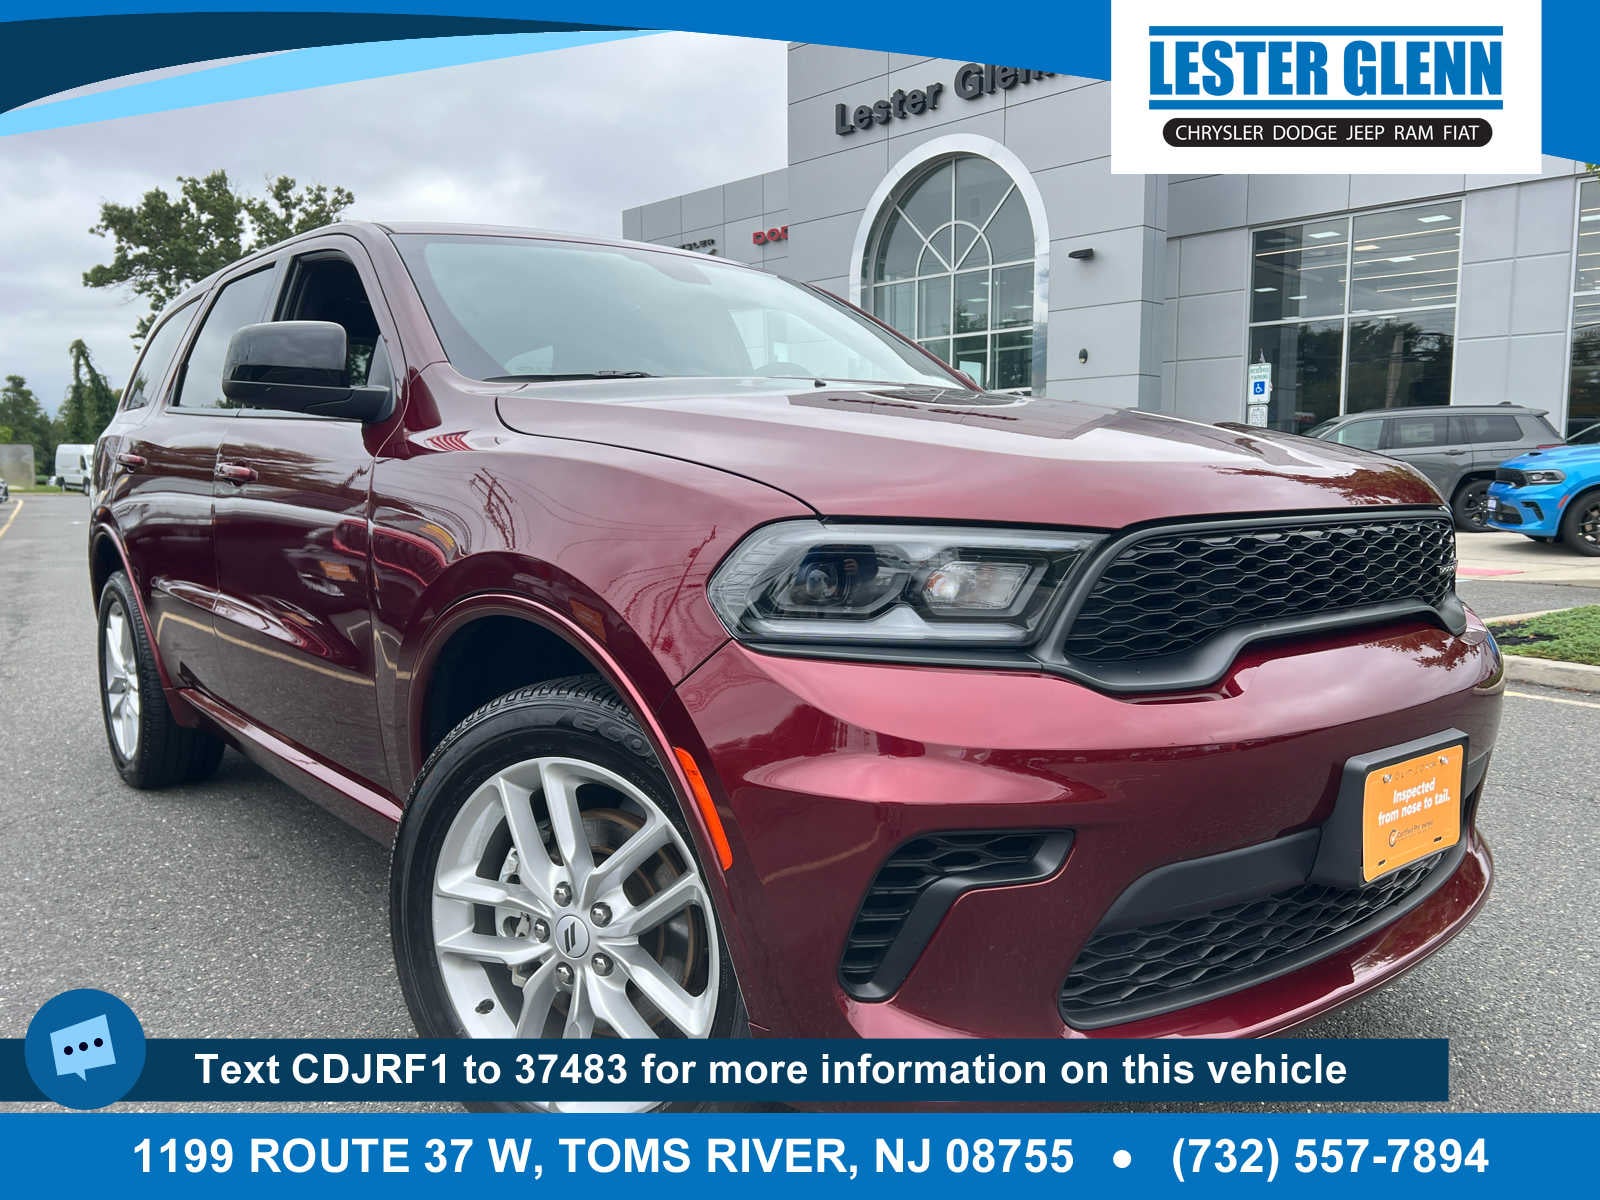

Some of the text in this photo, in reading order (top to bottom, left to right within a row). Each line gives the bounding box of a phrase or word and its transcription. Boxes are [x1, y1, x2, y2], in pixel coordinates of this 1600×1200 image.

[835, 62, 1056, 136] Lester Gle
[1392, 777, 1436, 805] Inspected
[1378, 810, 1399, 827] from
[1401, 801, 1422, 818] nose
[1424, 796, 1433, 809] to
